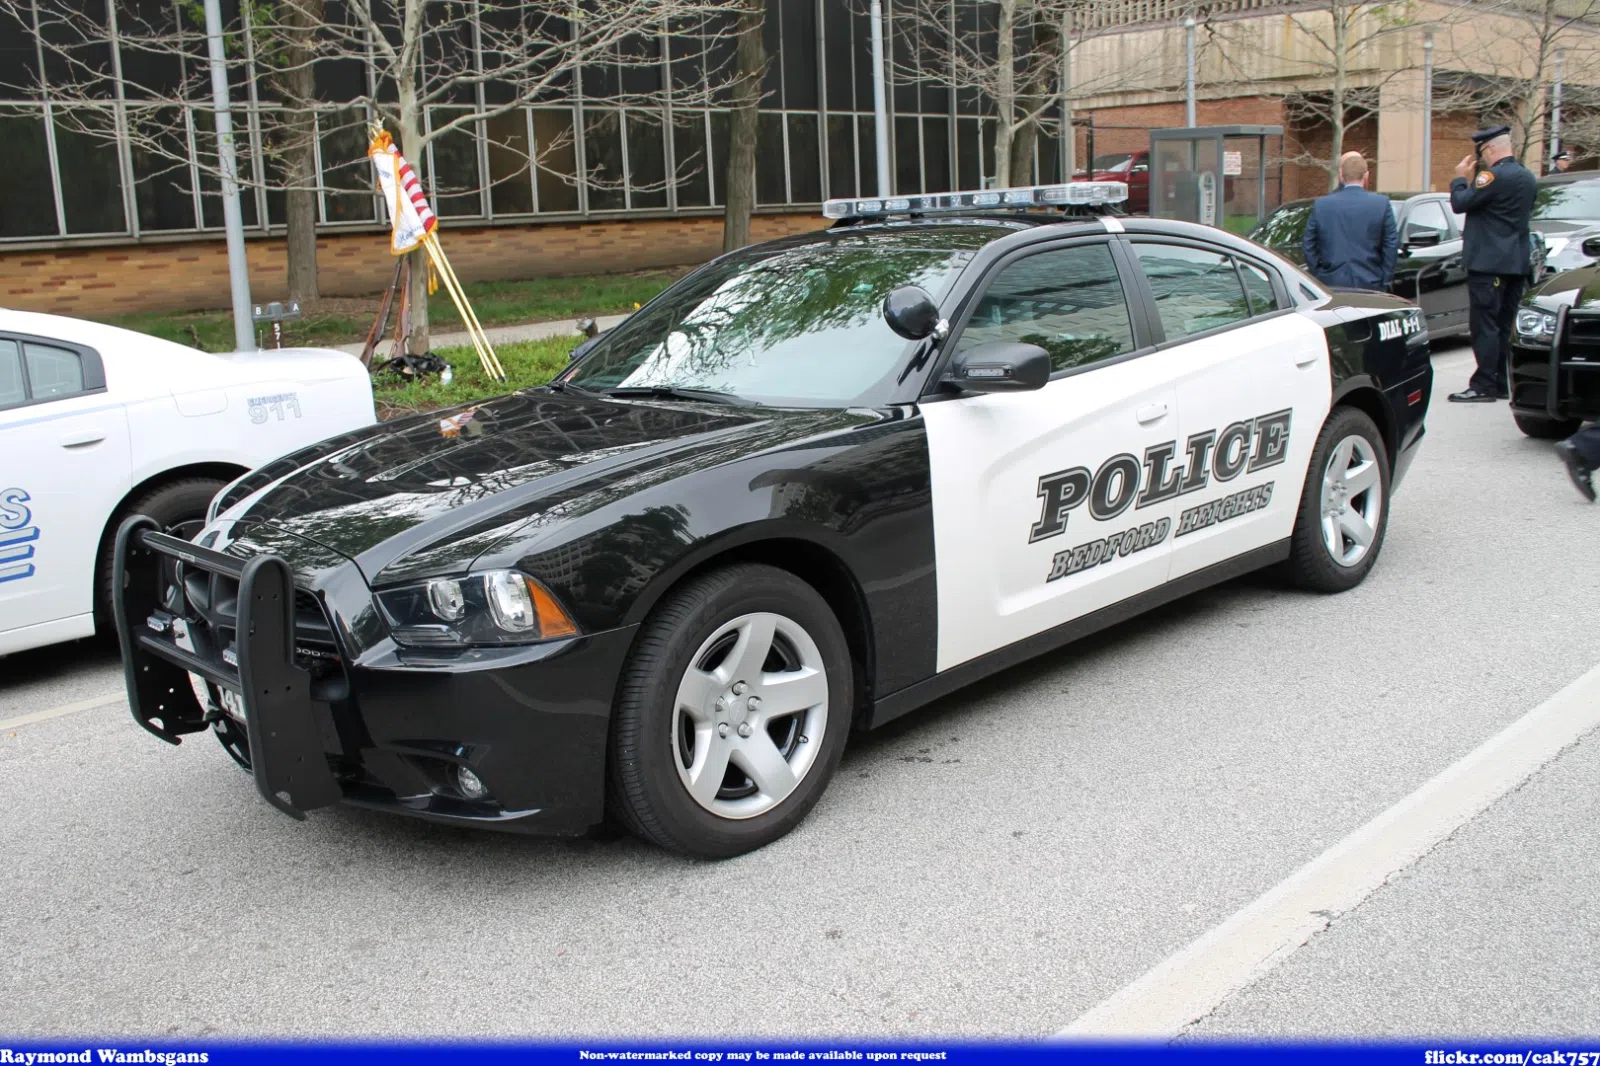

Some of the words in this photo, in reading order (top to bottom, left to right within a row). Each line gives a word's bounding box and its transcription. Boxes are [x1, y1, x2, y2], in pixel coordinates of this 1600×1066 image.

[255, 306, 262, 315] B
[292, 302, 300, 312] A
[1378, 318, 1403, 341] DIAL
[247, 399, 302, 425] 911
[1028, 407, 1293, 544] POLICE
[1046, 516, 1171, 583] BEDFORD
[1174, 480, 1275, 538] HEIGHTS
